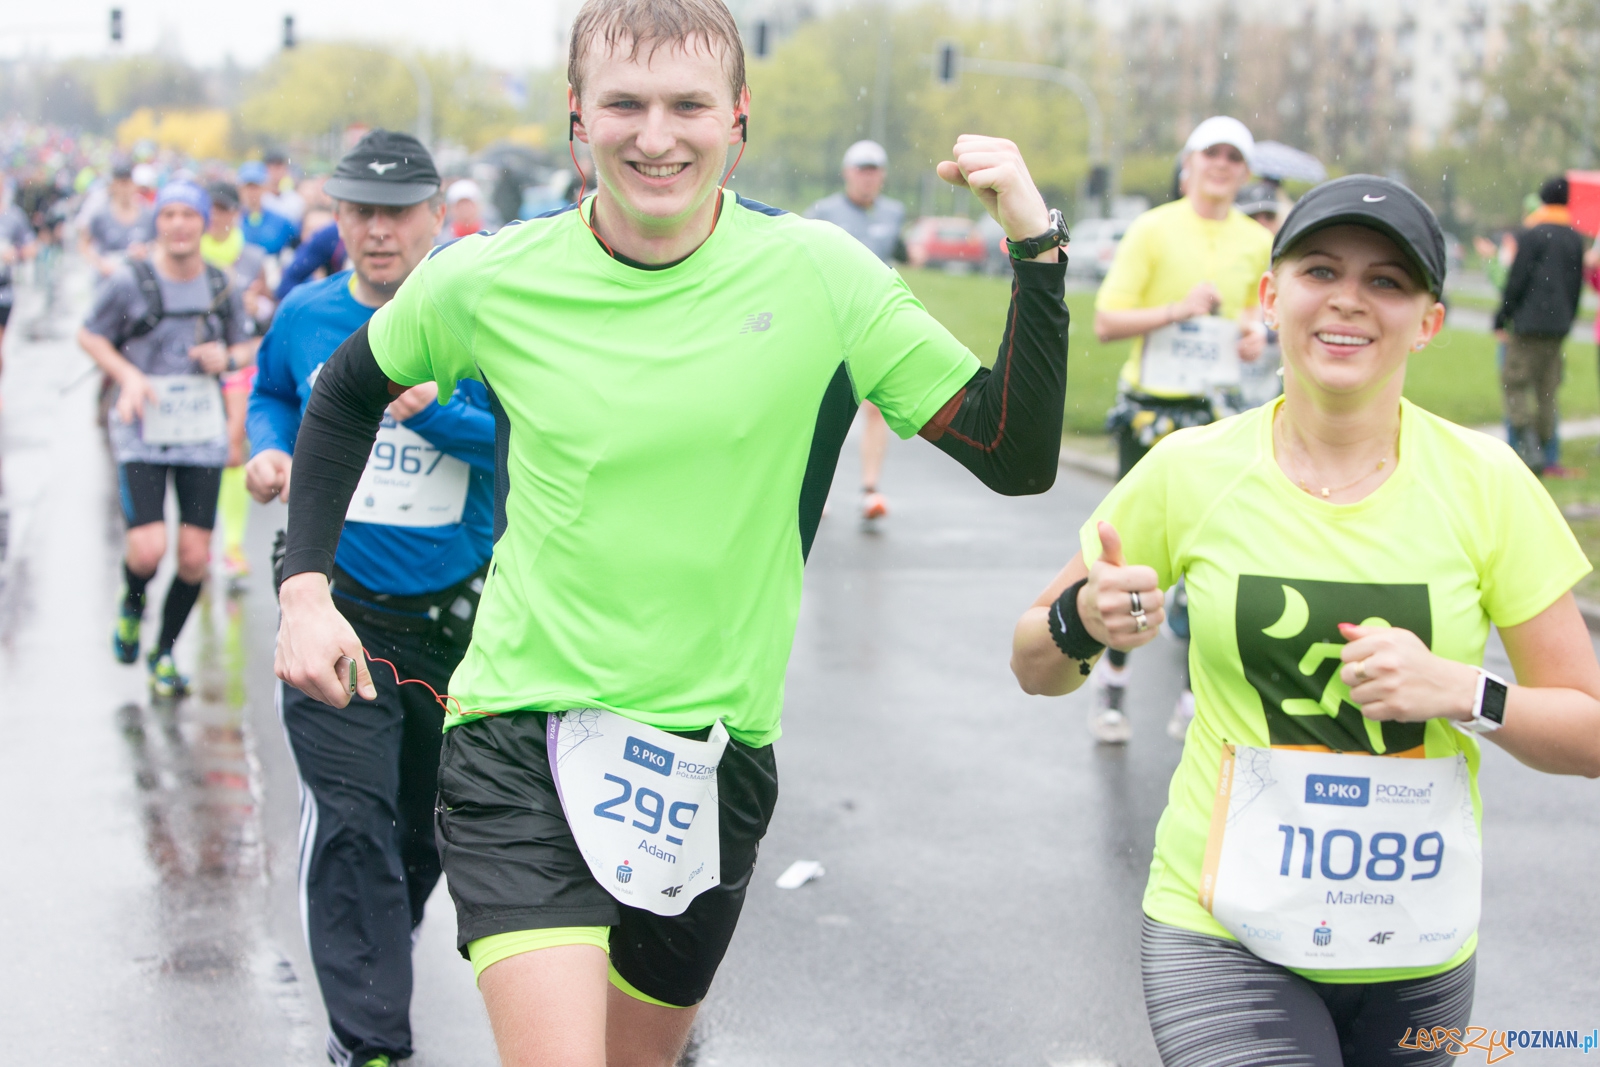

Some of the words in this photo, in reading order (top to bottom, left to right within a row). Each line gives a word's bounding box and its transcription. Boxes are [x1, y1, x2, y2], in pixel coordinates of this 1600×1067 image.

[367, 442, 443, 476] 967
[677, 760, 719, 775] POZna
[676, 770, 715, 781] PÓŁMARAT
[637, 839, 677, 864] Adam
[1278, 824, 1445, 882] 11089
[660, 884, 684, 898] 4F
[1325, 890, 1395, 906] Marlena
[1368, 931, 1395, 945] 4F
